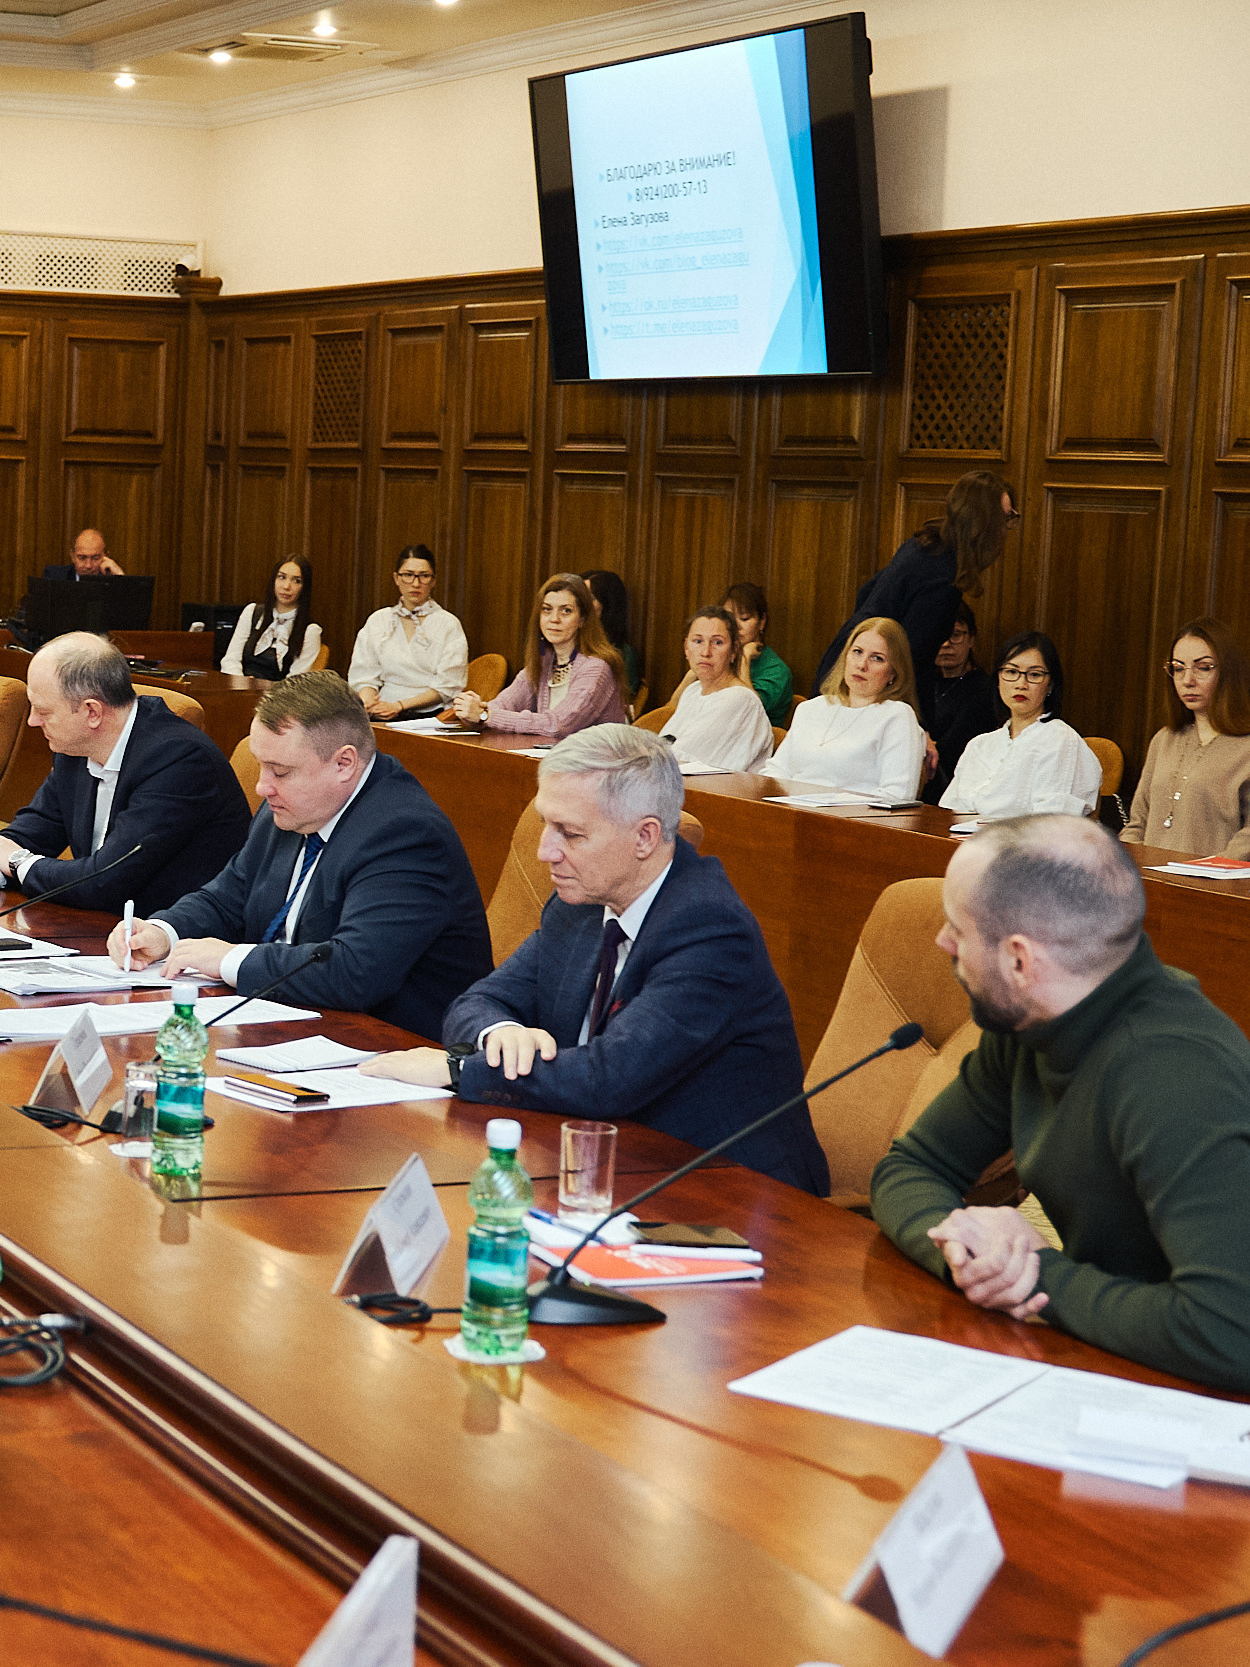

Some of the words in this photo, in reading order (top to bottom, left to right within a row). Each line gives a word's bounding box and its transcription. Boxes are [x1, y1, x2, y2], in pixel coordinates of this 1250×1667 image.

[606, 161, 663, 182] БЛАГОДАРЮ
[665, 160, 677, 175] ЗА
[679, 151, 736, 172] ВНИМАНИЕ!
[635, 179, 708, 203] 8(924)200-57-13
[601, 215, 628, 229] Елена
[630, 211, 670, 228] Загузова
